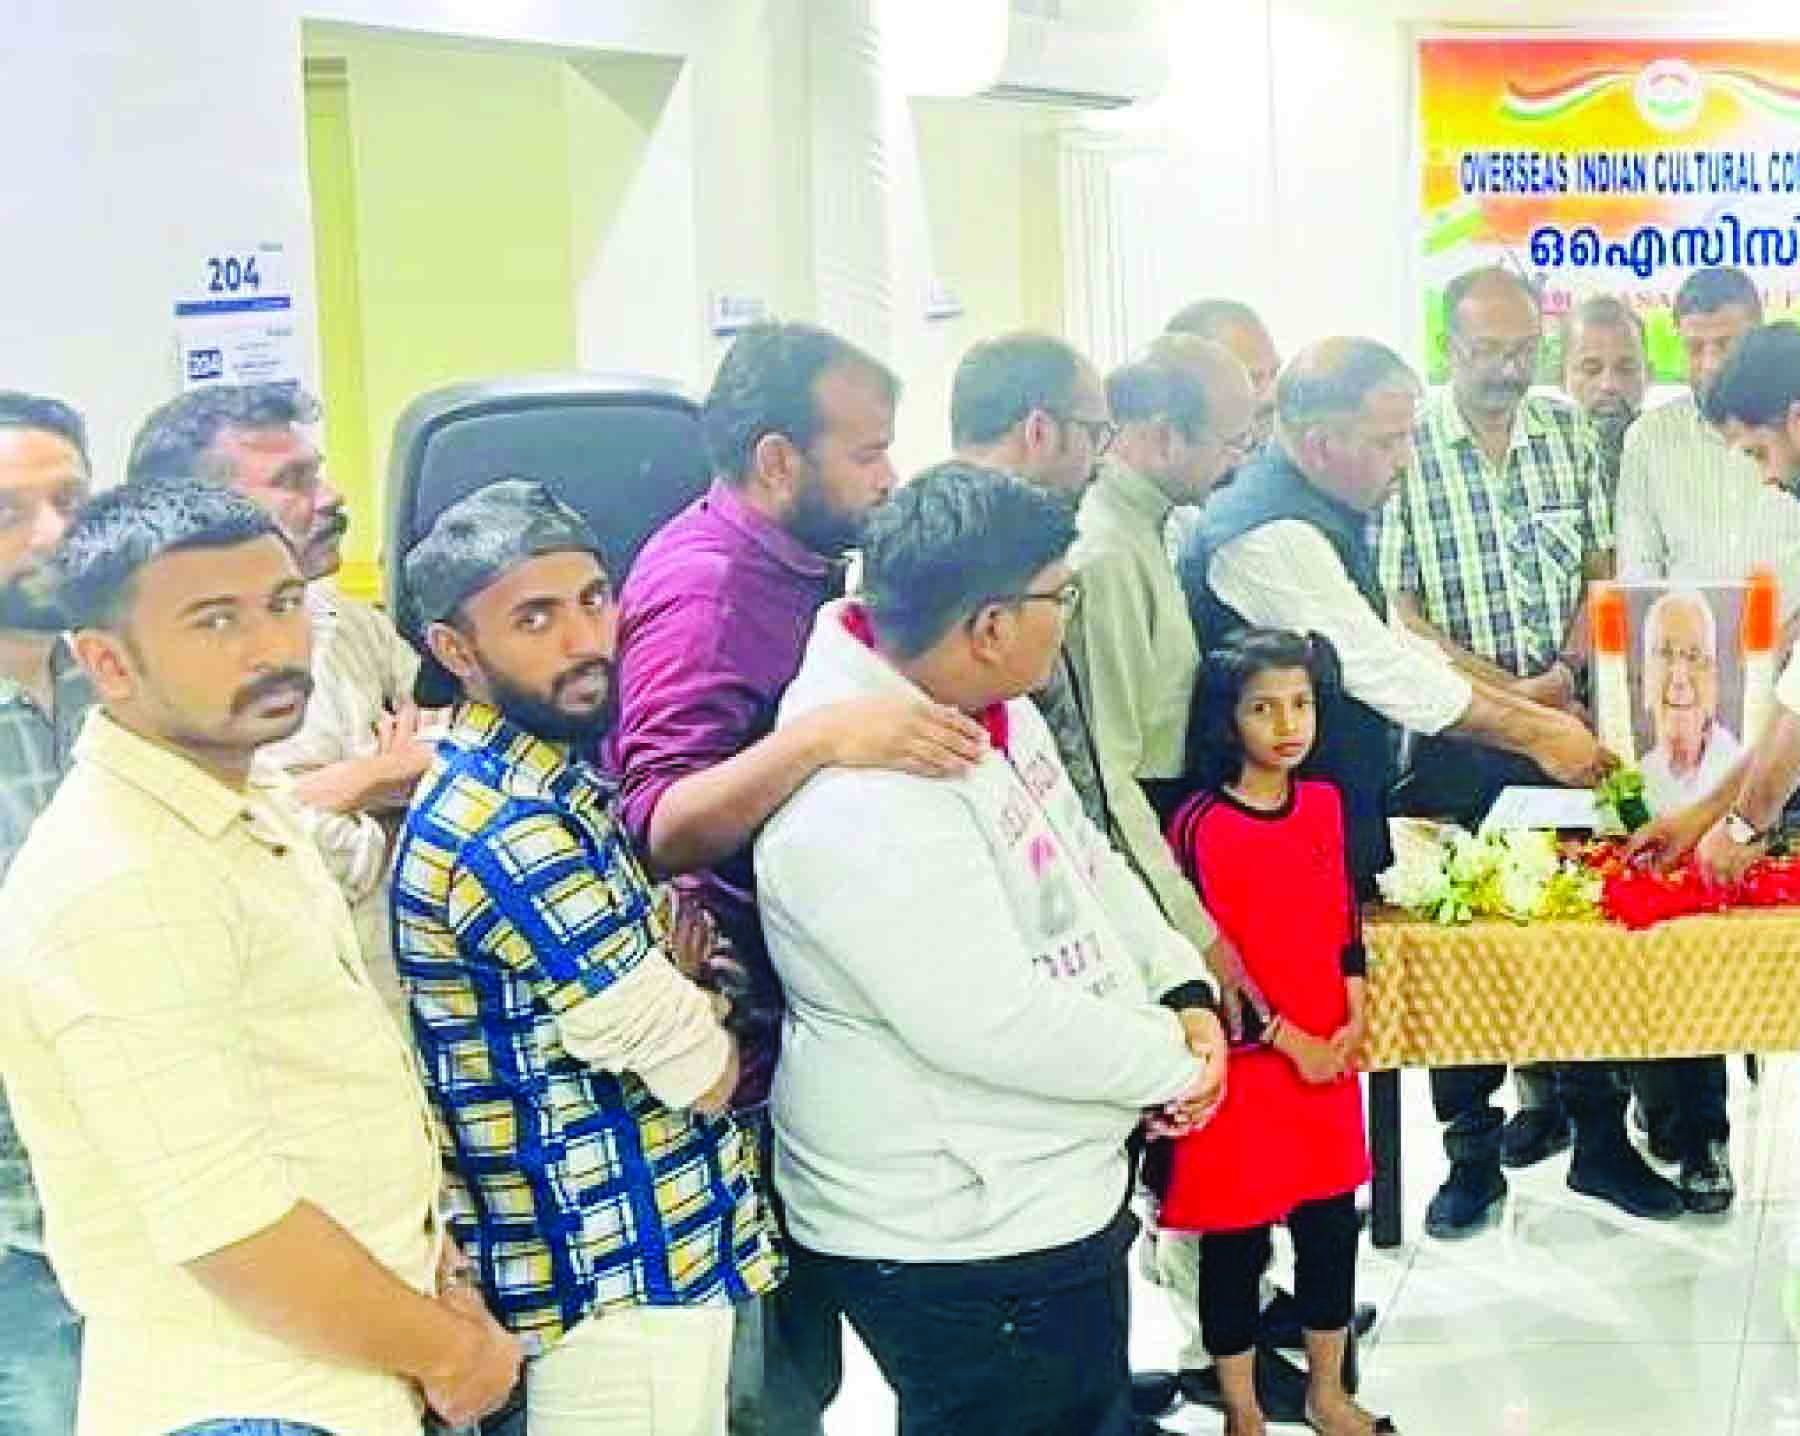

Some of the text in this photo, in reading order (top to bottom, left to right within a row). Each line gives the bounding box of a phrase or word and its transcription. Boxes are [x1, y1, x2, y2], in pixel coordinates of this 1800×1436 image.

[1461, 151, 1568, 193] OVERSEAS
[1577, 151, 1646, 193] INDIAN
[1655, 151, 1761, 193] CULTURAL
[207, 255, 260, 291] 204
